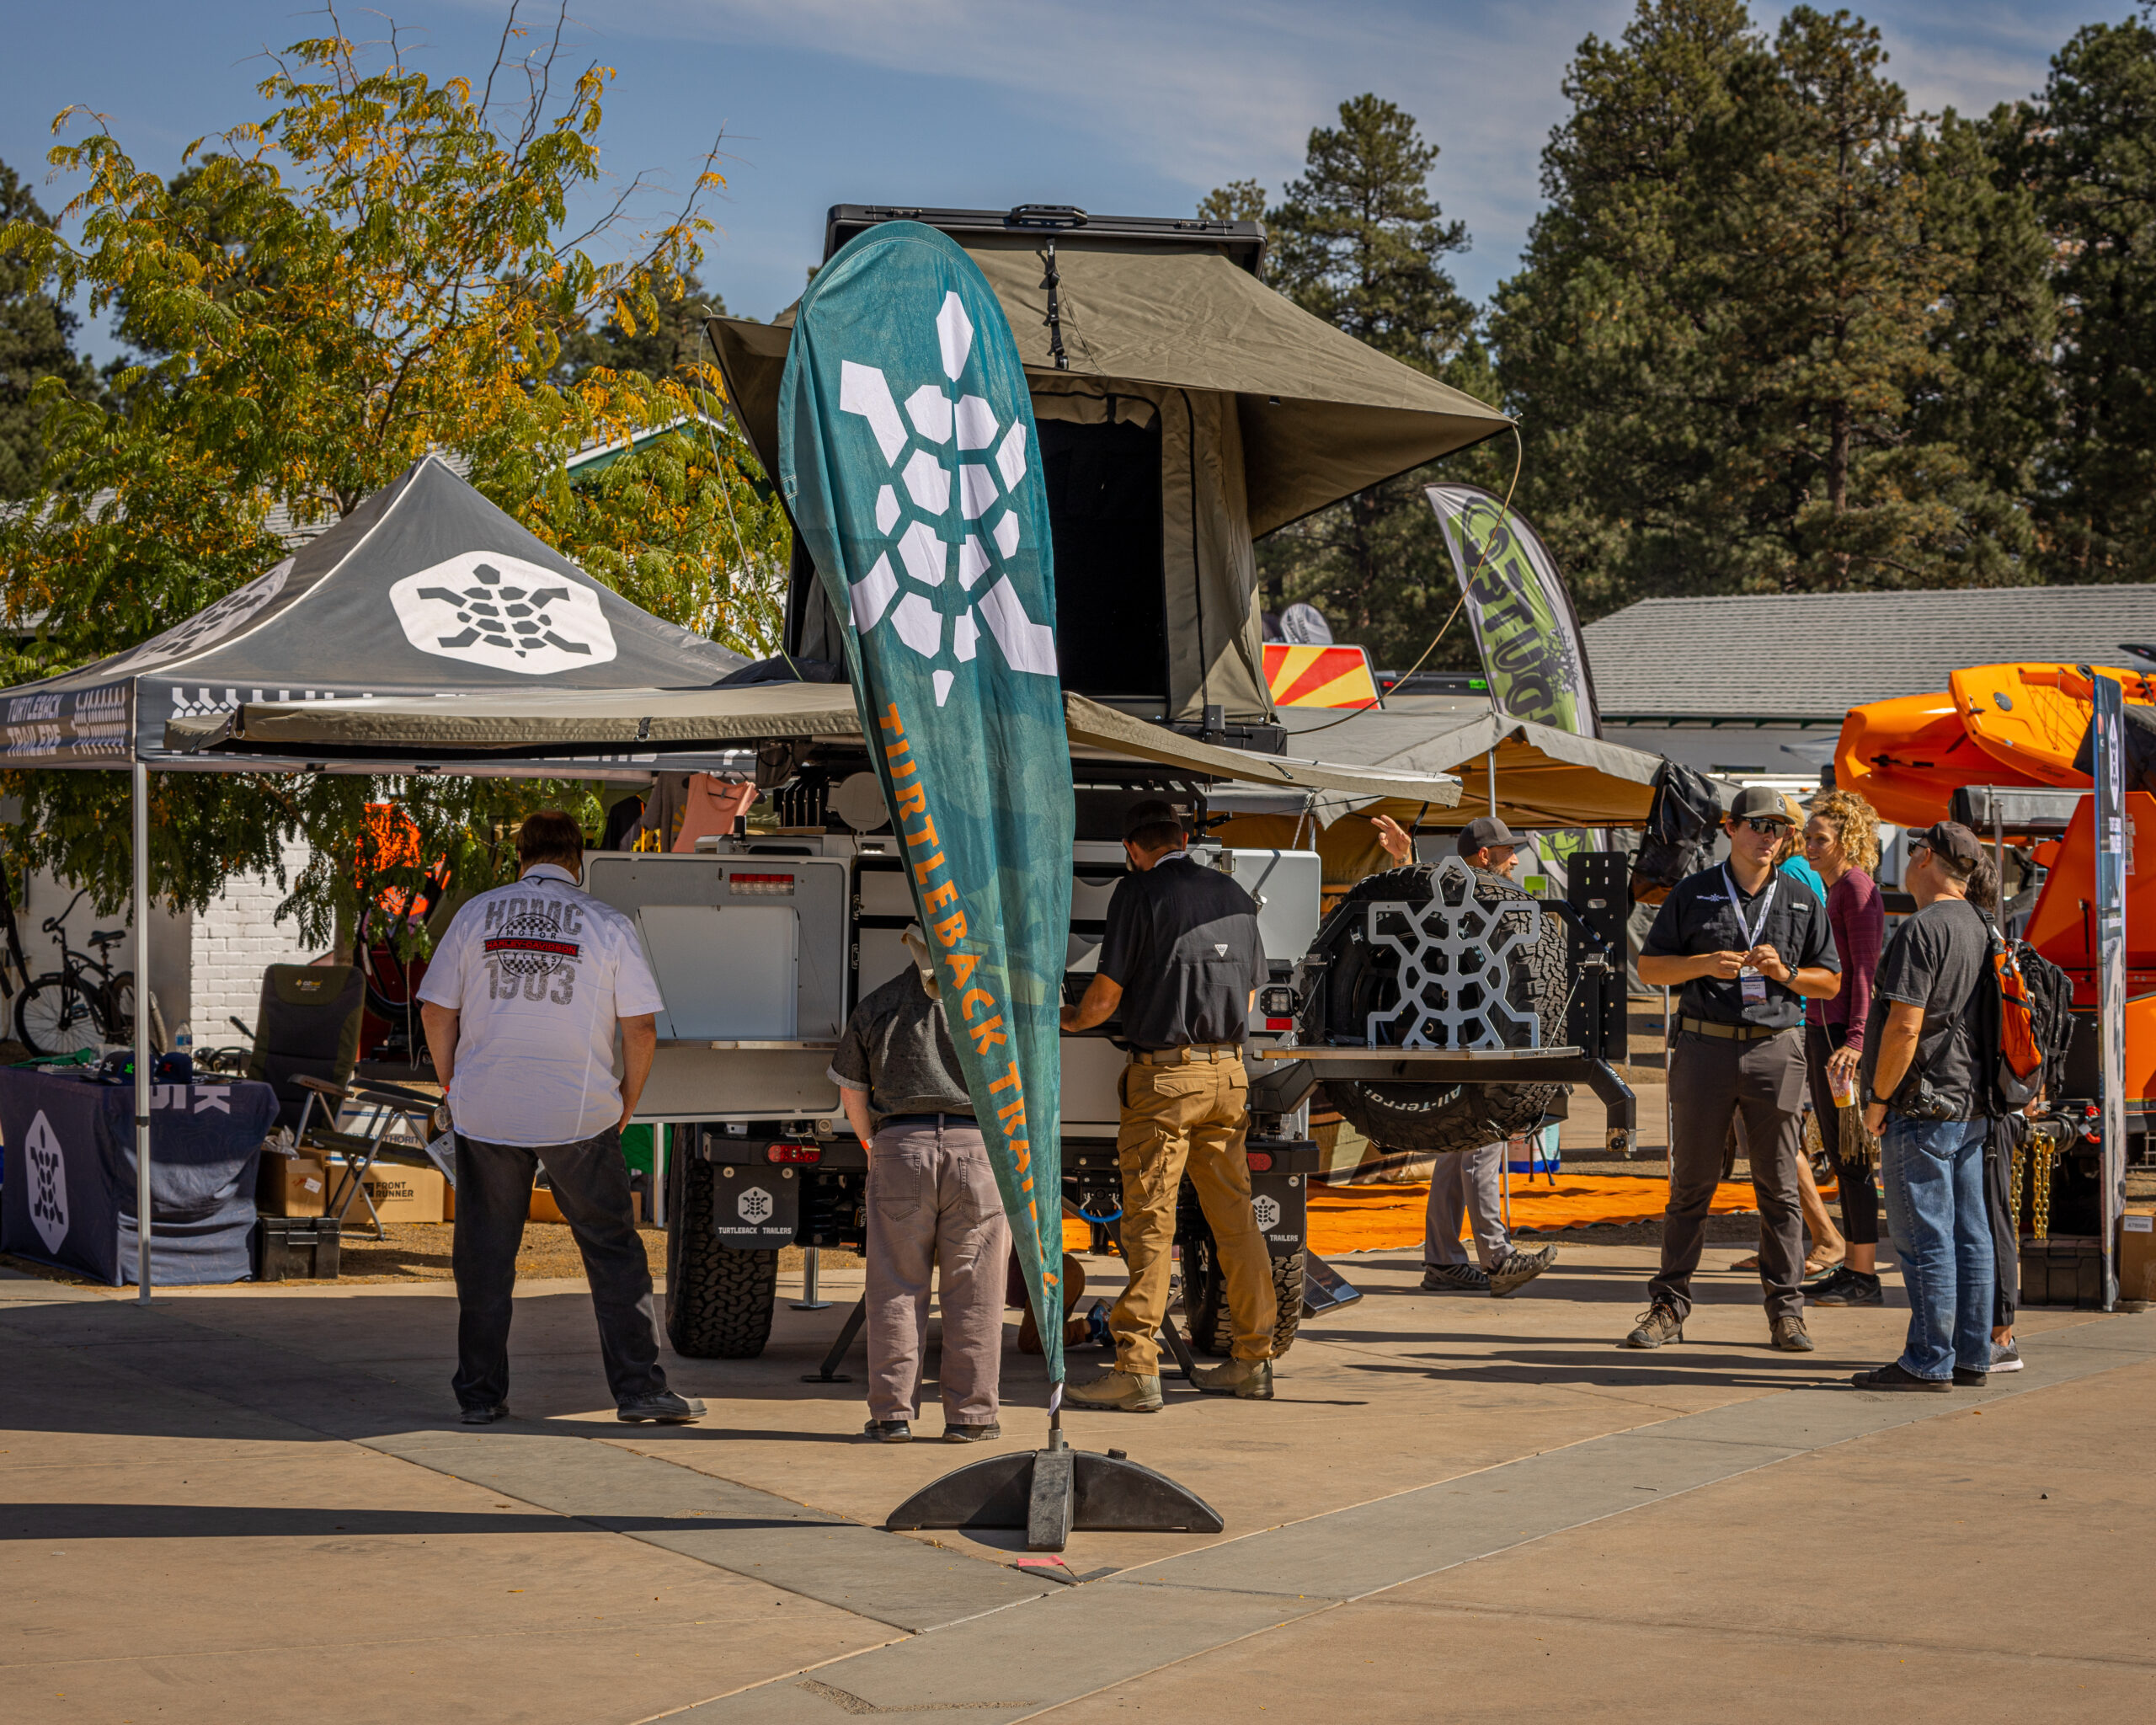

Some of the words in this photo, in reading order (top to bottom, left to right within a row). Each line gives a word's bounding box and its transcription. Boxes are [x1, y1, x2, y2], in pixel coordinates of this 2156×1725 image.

[8, 693, 64, 723] TURTLEBACK
[7, 724, 61, 757] TRAILERS
[879, 702, 1007, 1057] TURTLEBACK
[506, 929, 557, 940] MOTOR
[486, 939, 579, 957] HARLEY-DAVIDSON
[503, 952, 557, 962] CYCLES
[485, 959, 576, 1005] 1903
[376, 1181, 407, 1190] FRONT
[376, 1189, 414, 1198] RUNNER
[718, 1226, 757, 1235] TURTLEBACK
